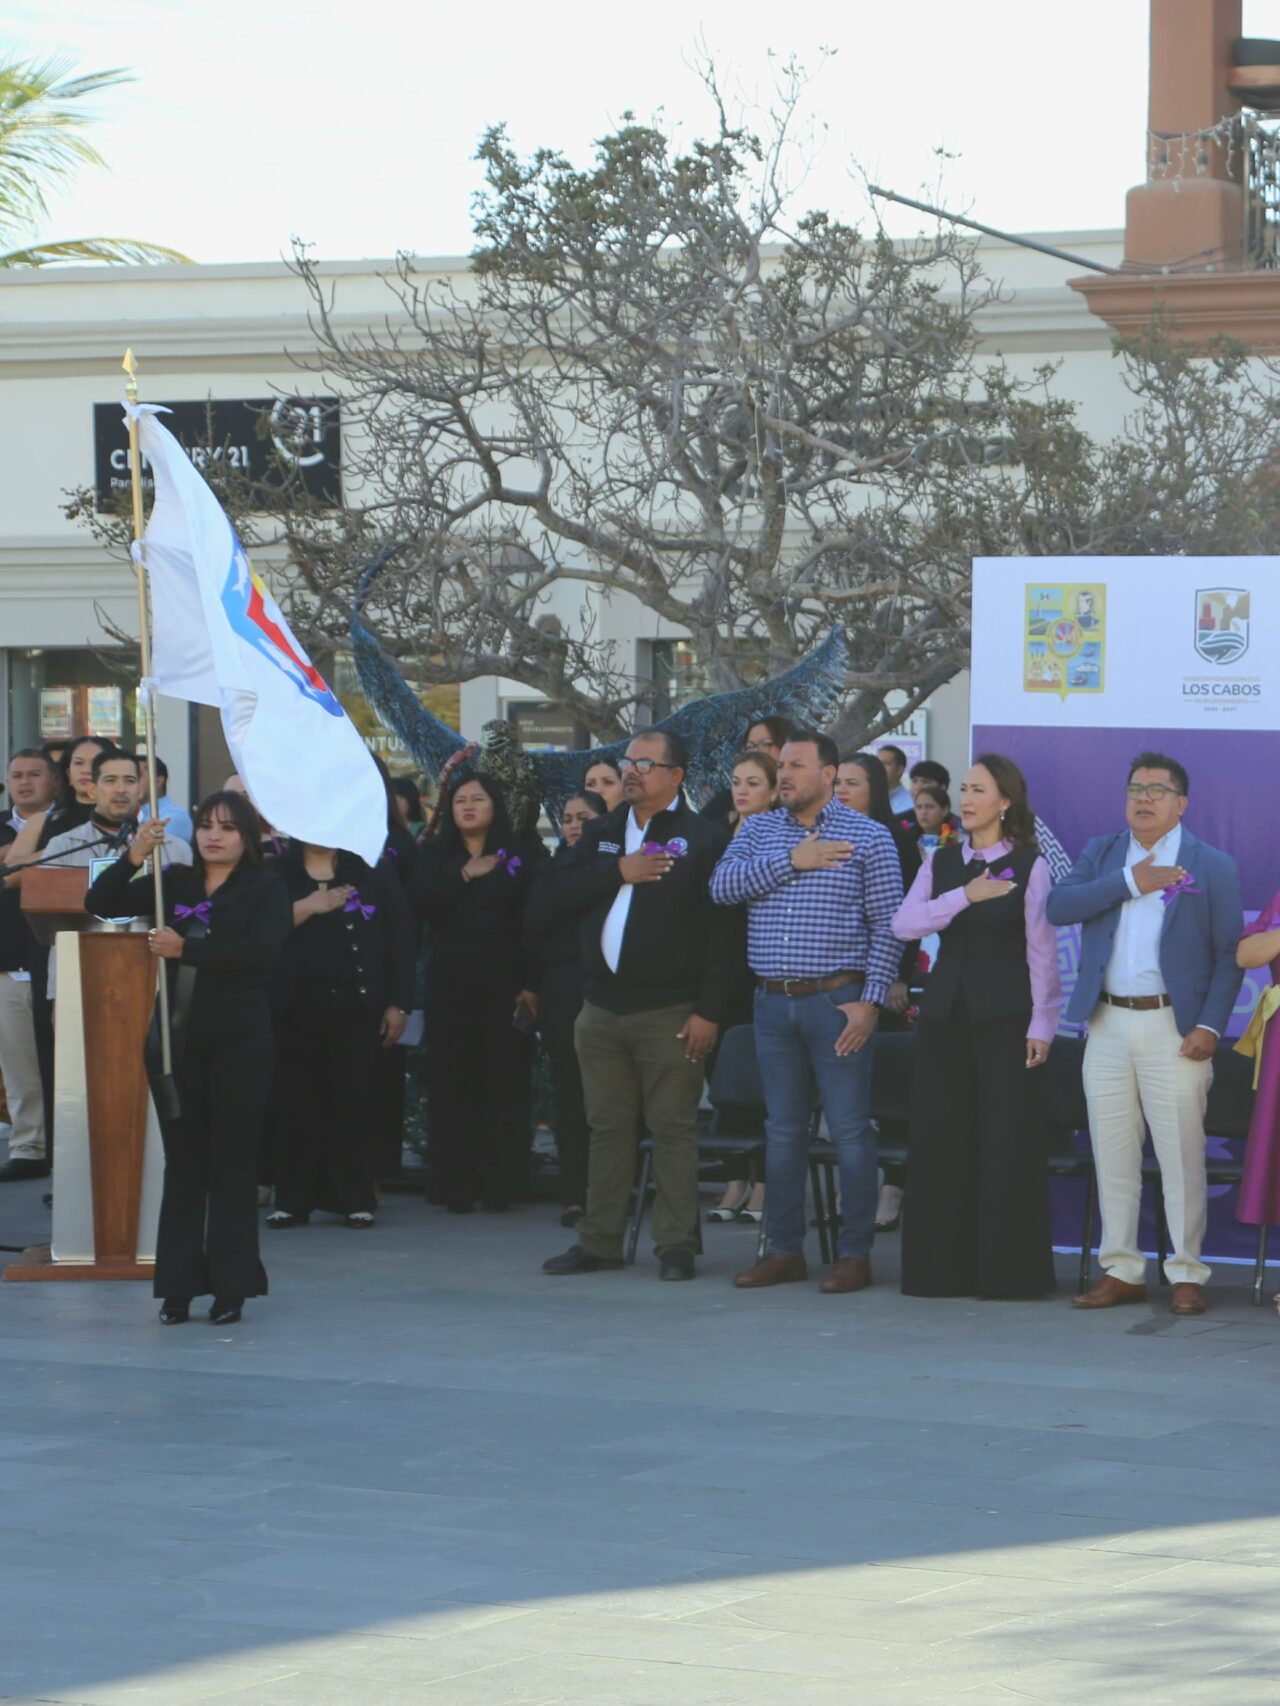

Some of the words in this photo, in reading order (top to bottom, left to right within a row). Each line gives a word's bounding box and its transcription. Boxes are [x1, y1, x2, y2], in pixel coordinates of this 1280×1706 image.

[227, 446, 250, 468] 21
[1182, 683, 1209, 695] LOS
[1212, 683, 1261, 696] CABOS
